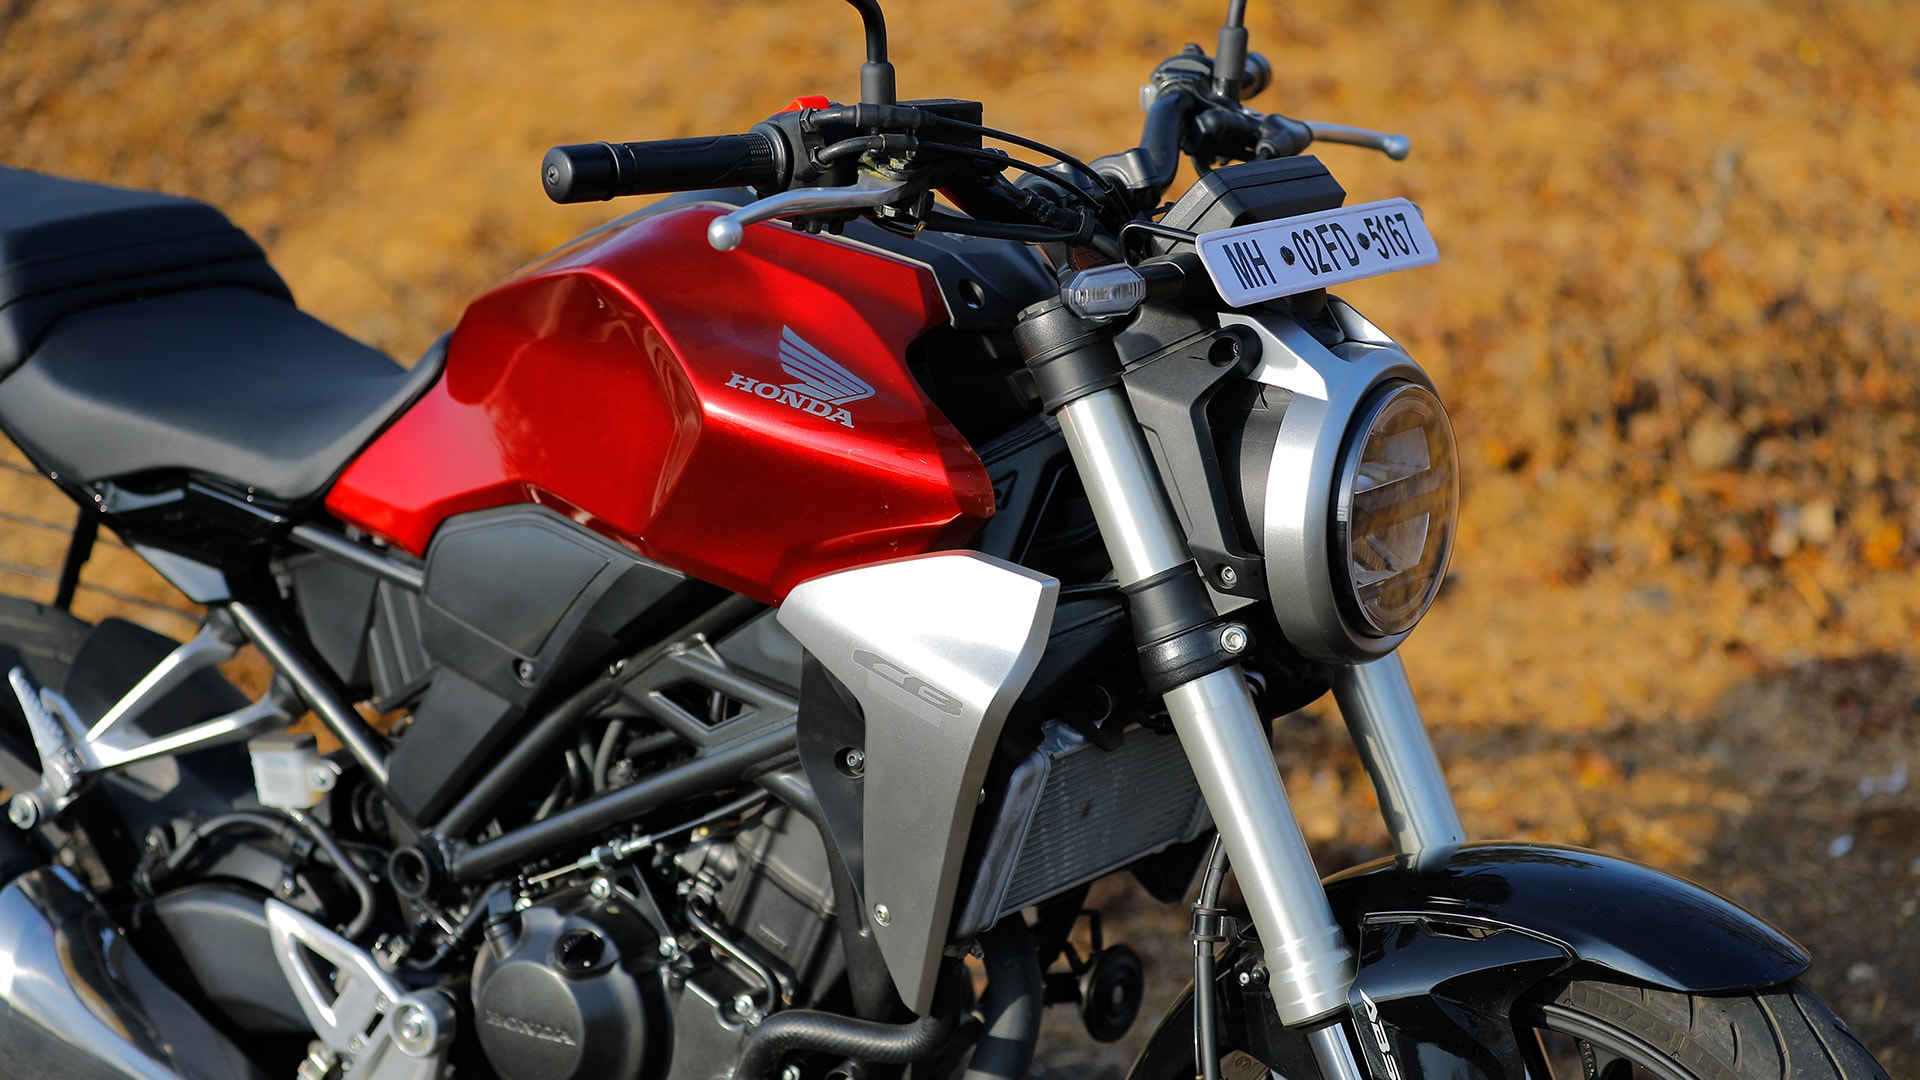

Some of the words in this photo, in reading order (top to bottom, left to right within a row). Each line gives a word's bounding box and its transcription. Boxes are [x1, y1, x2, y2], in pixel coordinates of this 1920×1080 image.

[1221, 238, 1277, 290] MH
[1291, 222, 1360, 276] 02FD
[1363, 212, 1420, 260] 5167
[725, 372, 855, 429] HONDA
[852, 649, 964, 717] CB
[486, 1009, 577, 1047] HONDA
[1358, 988, 1402, 1080] ABS
